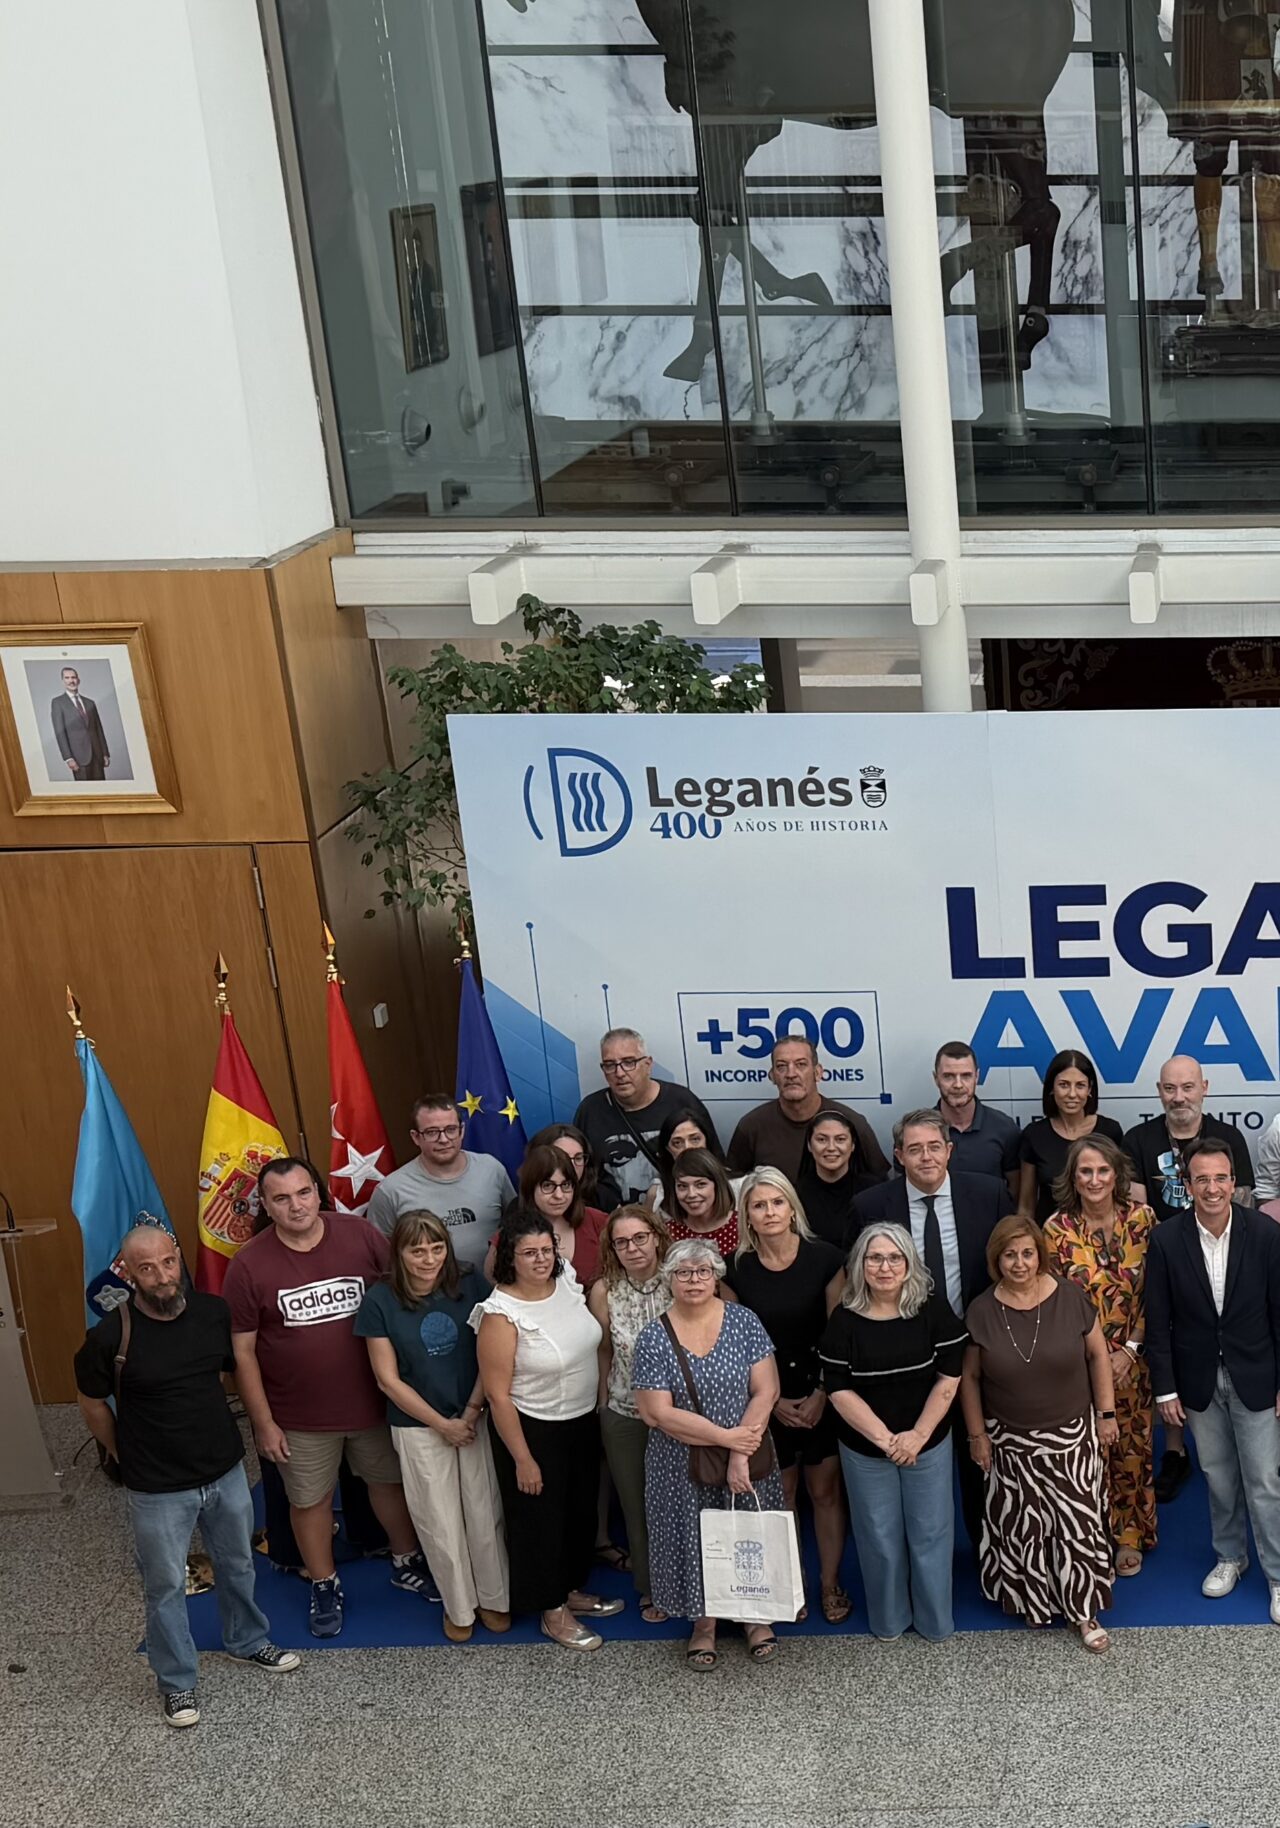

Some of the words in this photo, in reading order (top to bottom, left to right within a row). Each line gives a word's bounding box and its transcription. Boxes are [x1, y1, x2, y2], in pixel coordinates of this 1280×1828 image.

[645, 766, 853, 817] Leganés
[650, 811, 722, 839] 400
[733, 820, 777, 832] AÑOS
[783, 821, 804, 831] DE
[810, 819, 889, 831] HISTORIA
[697, 1006, 865, 1059] +500
[704, 1068, 865, 1083] INCORPONES
[289, 1286, 357, 1311] adidas
